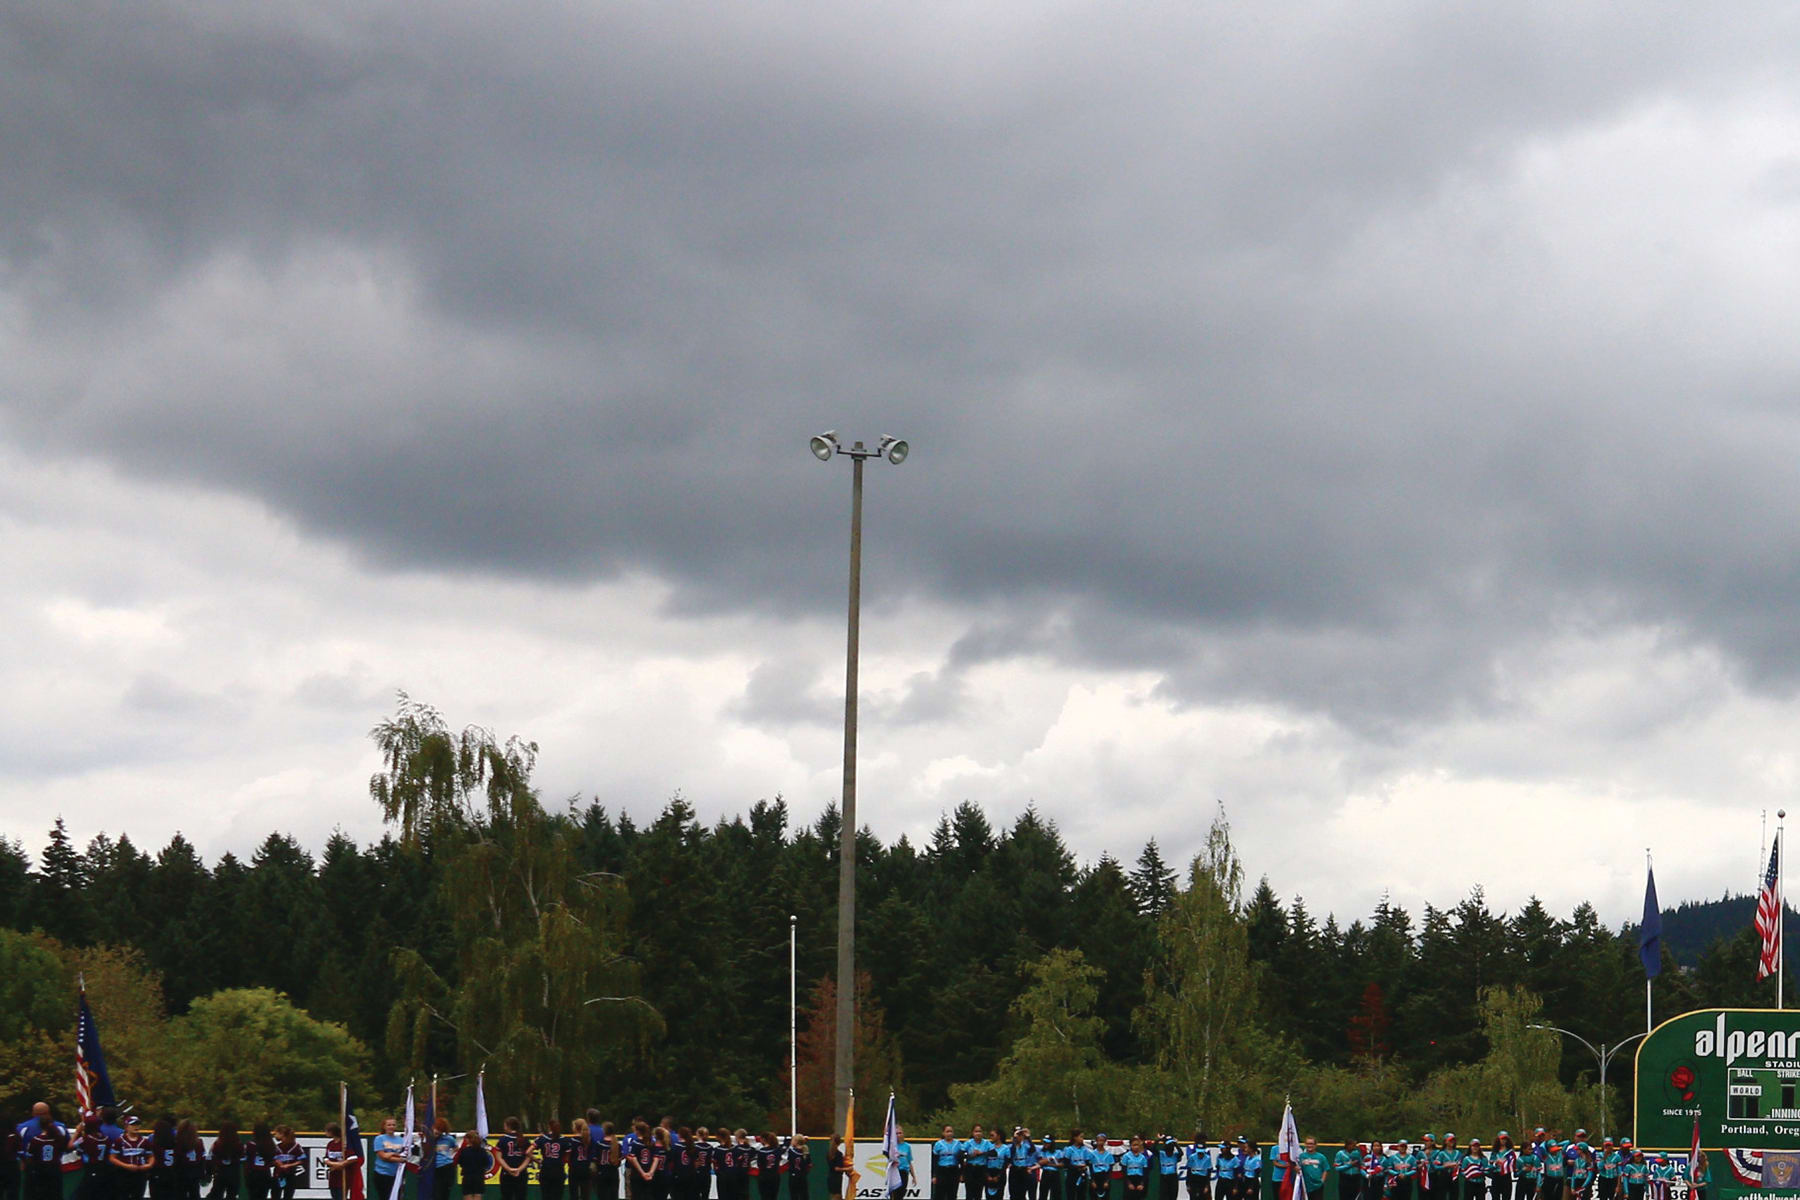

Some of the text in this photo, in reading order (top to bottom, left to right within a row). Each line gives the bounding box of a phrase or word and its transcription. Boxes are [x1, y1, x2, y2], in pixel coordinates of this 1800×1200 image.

[1737, 1069, 1753, 1078] BALL
[1777, 1070, 1800, 1078] STRIKE
[1733, 1087, 1760, 1095] WORLD
[1721, 1124, 1769, 1136] Portland,
[543, 1142, 561, 1158] 12
[164, 1149, 174, 1167] 5
